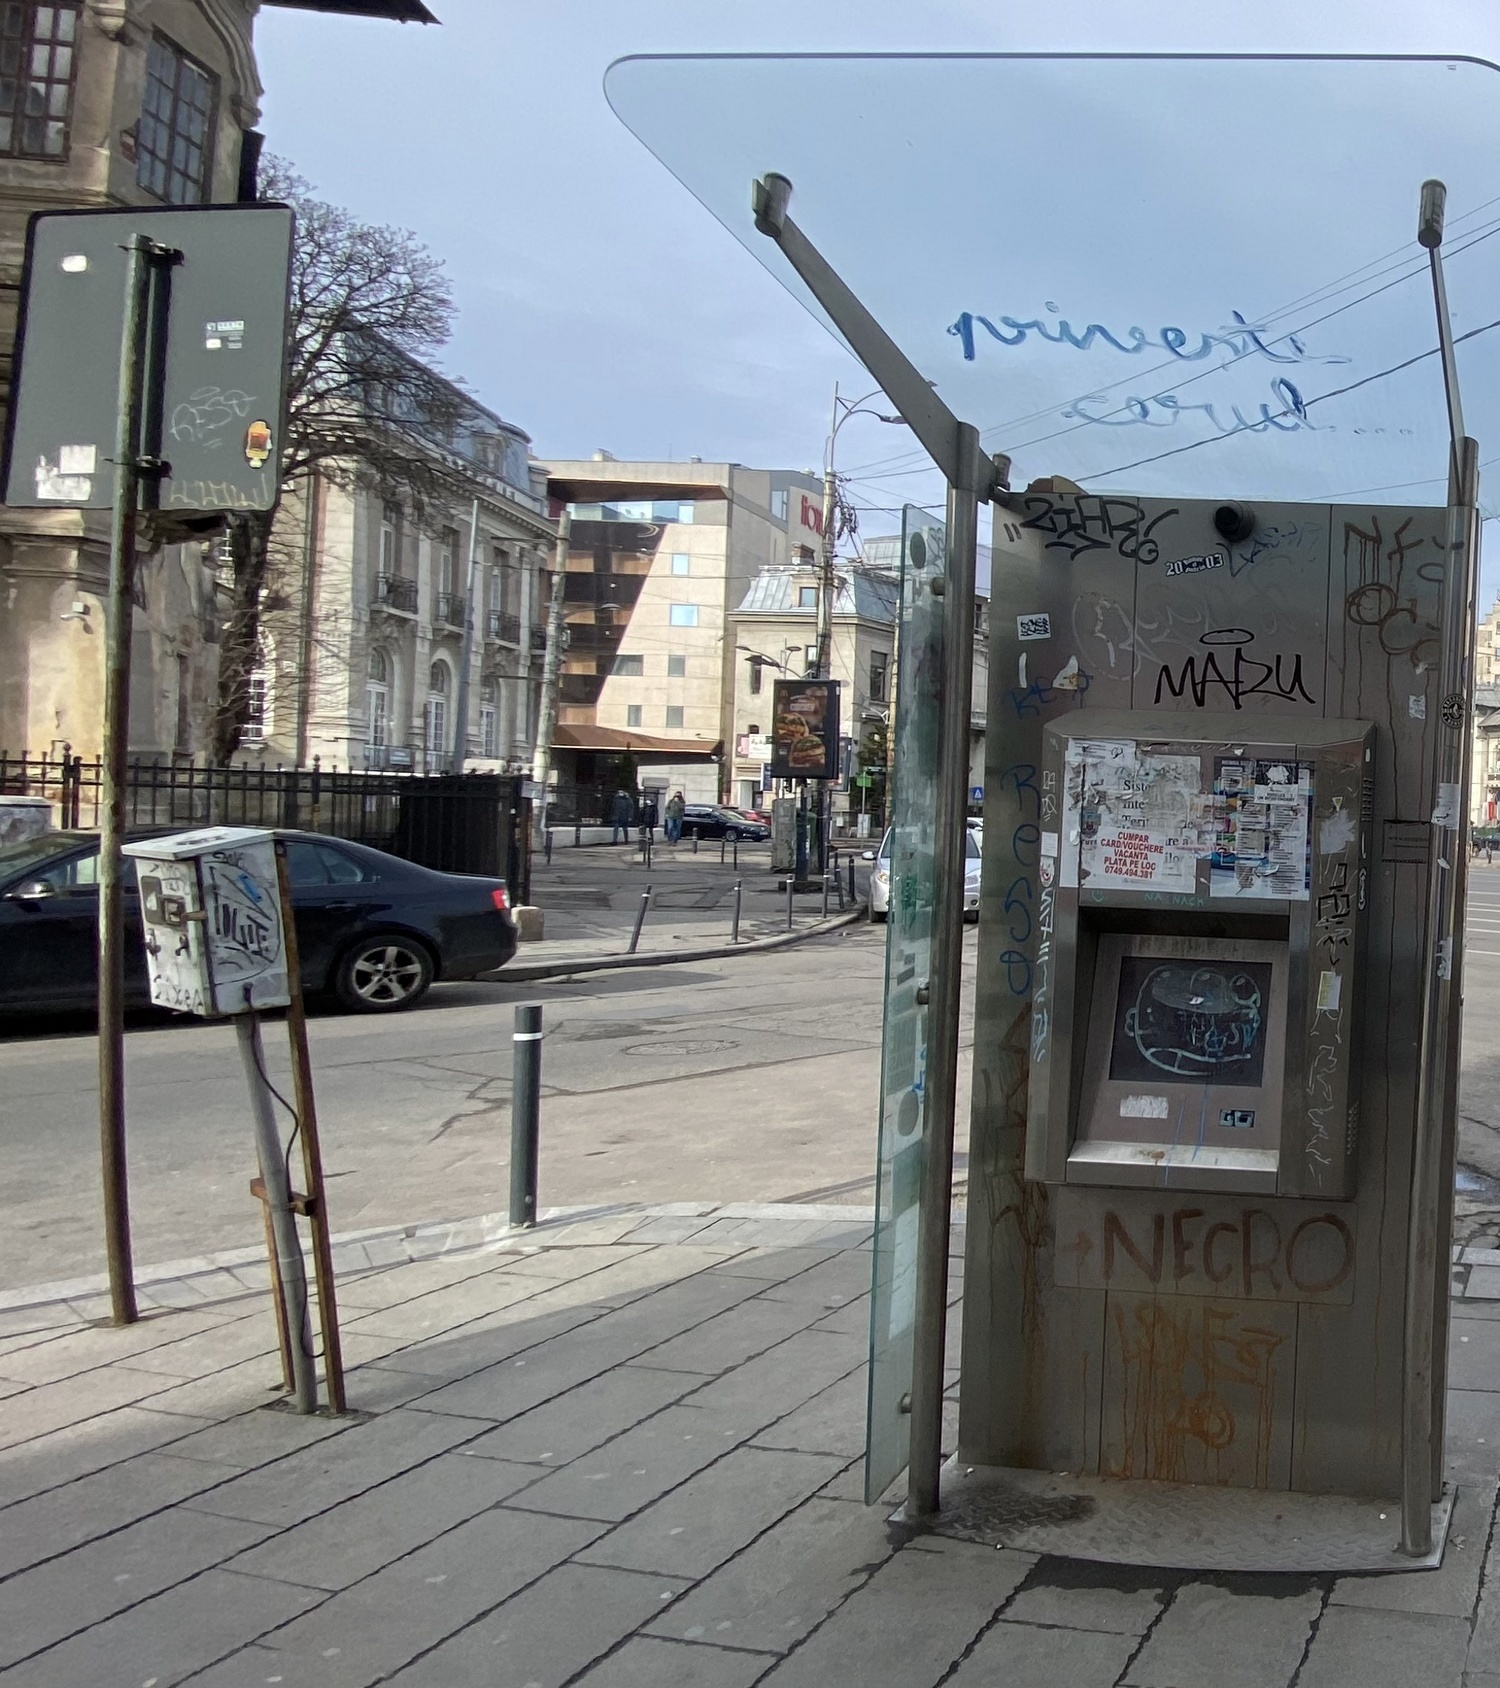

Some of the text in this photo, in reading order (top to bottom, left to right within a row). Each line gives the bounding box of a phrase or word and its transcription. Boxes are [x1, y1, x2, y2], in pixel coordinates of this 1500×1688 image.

[1117, 831, 1149, 843] CUMPAR
[1114, 848, 1149, 860] VACANTA
[1104, 856, 1157, 870] PLATA PE LOC
